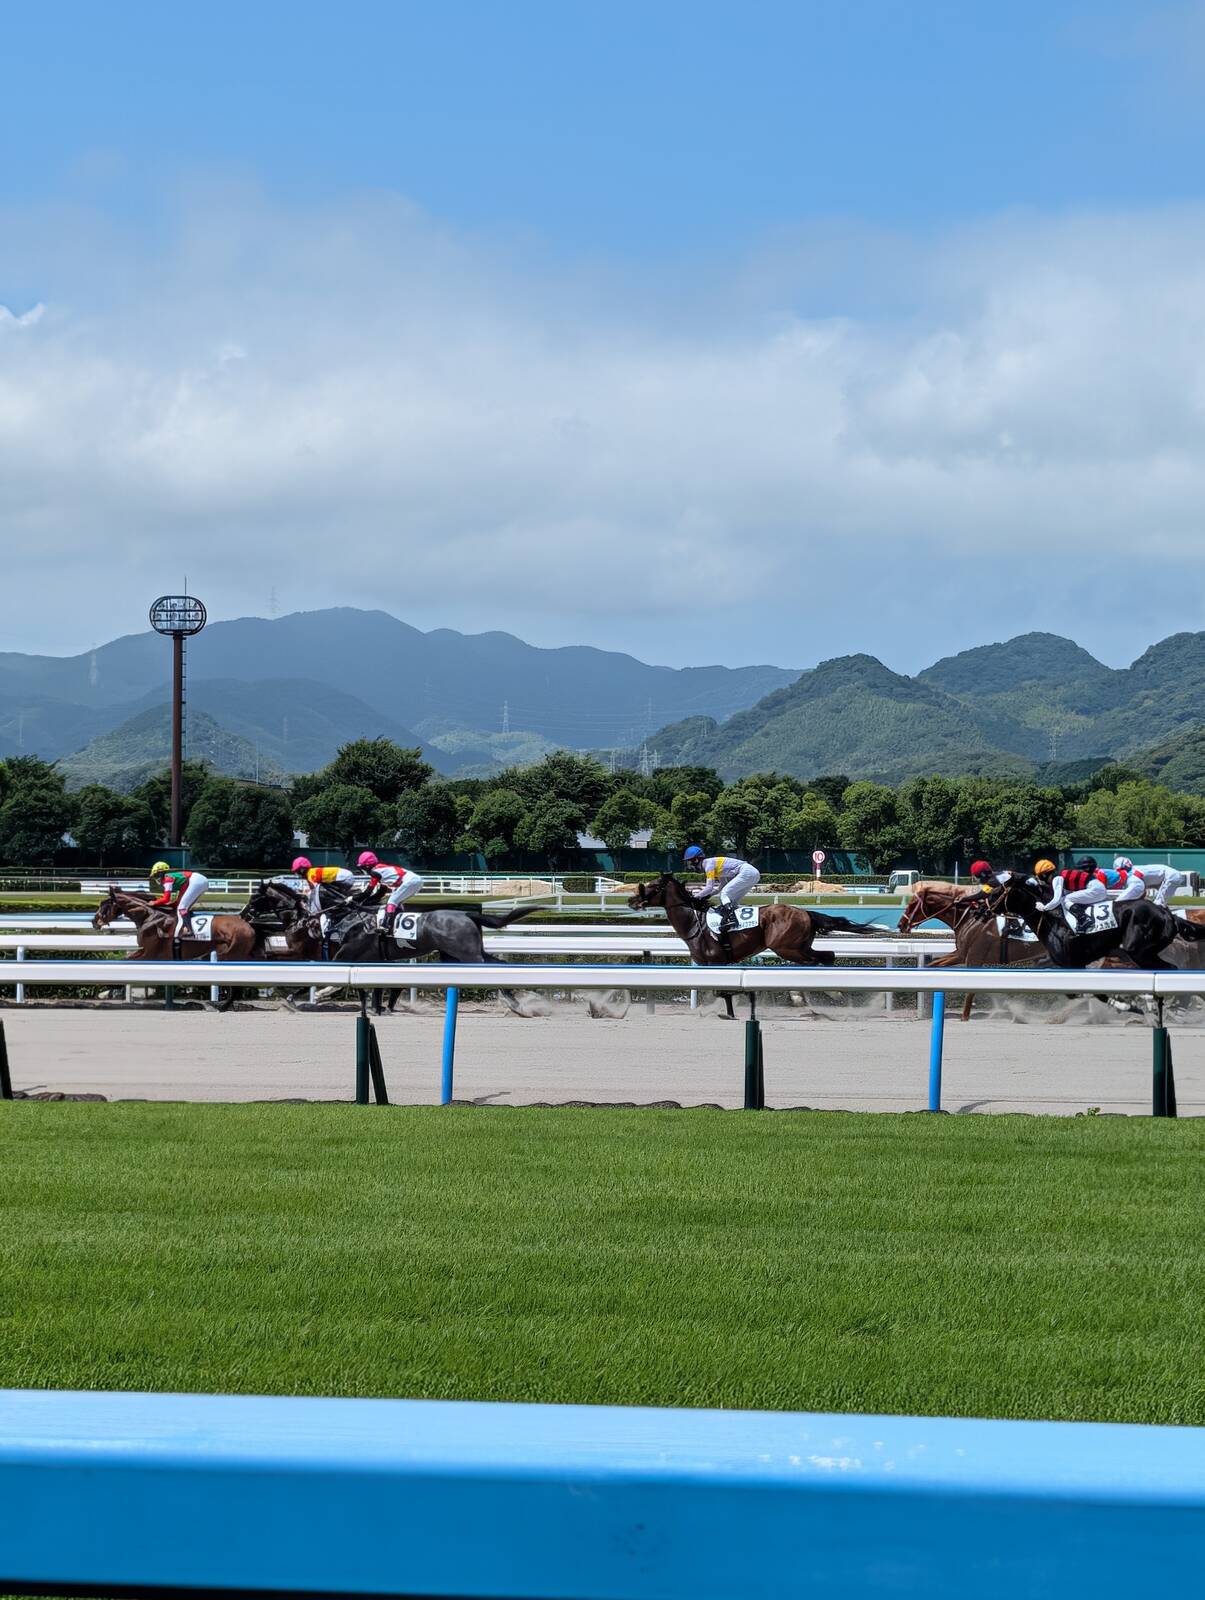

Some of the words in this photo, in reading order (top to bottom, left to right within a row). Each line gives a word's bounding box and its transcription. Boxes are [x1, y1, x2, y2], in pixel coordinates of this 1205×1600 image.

[815, 852, 823, 861] 10
[740, 907, 754, 920] 8
[195, 917, 207, 932] 9
[396, 913, 415, 930] 16
